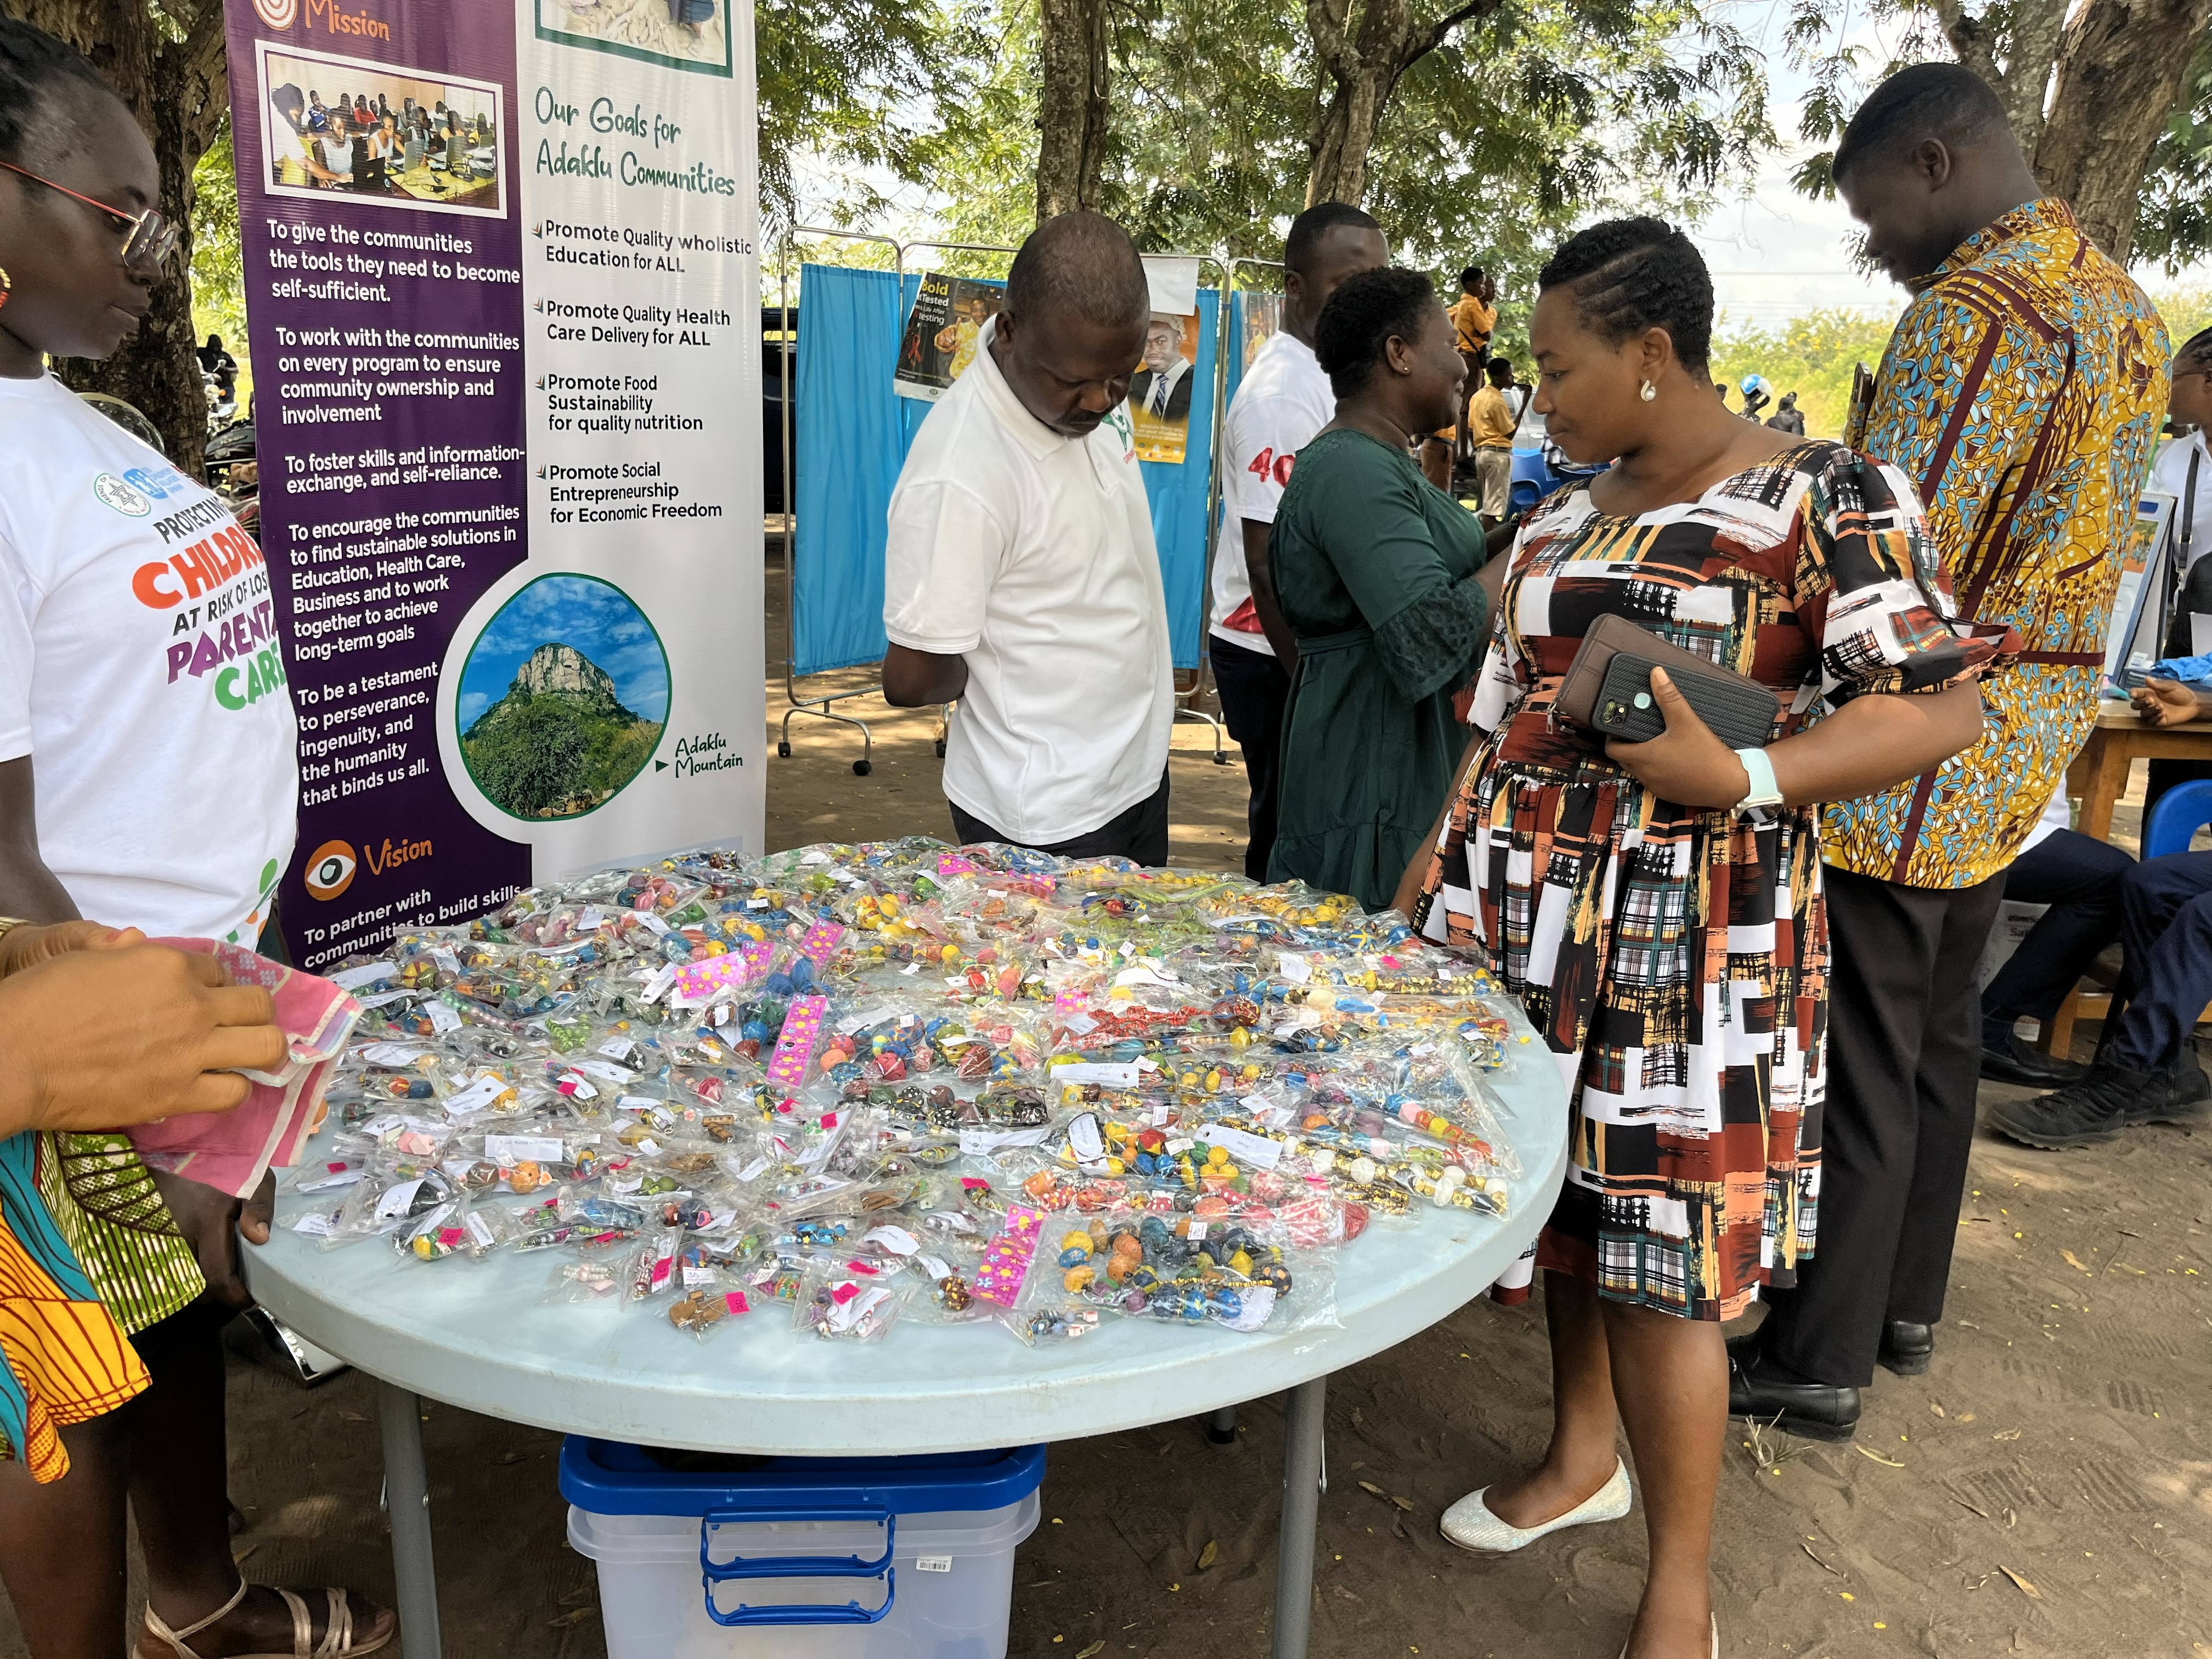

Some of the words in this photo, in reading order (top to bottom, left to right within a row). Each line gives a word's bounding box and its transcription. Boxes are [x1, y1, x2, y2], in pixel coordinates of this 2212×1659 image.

[305, 0, 390, 42] Mission
[535, 86, 579, 126] Our
[590, 97, 647, 139] Goals
[654, 114, 681, 149] for
[536, 138, 612, 179] Adaklu
[621, 151, 735, 196] Communities
[267, 219, 287, 239] To
[292, 224, 326, 244] give
[330, 225, 358, 244] the
[364, 229, 473, 254] communities
[546, 219, 619, 242] Promote
[624, 228, 673, 252] Quality
[678, 234, 752, 255] wholistic
[269, 249, 297, 269] the
[301, 251, 342, 272] tools
[347, 254, 384, 278] they
[388, 259, 427, 278] need
[432, 262, 452, 279] to
[456, 264, 520, 284] become
[546, 245, 629, 268] Education
[634, 253, 652, 269] for
[656, 257, 685, 273] ALL
[272, 278, 391, 302] self-sufficient.
[922, 279, 949, 296] Bold
[922, 294, 949, 306] Tested
[548, 301, 619, 320] Promote
[623, 305, 670, 326] Quality
[676, 308, 730, 325] Health
[276, 328, 296, 346] To
[300, 328, 341, 347] work
[344, 329, 382, 347] with
[385, 329, 410, 347] the
[414, 331, 520, 351] communities
[548, 324, 586, 341] Care
[592, 327, 648, 347] Delivery
[653, 328, 673, 345] for
[679, 331, 710, 346] ALL
[278, 357, 300, 372] on
[304, 357, 348, 376] every
[352, 356, 419, 376] program
[423, 356, 441, 372] to
[445, 358, 501, 373] ensure
[549, 374, 620, 391] Promote
[625, 375, 657, 391] Food
[280, 379, 372, 401] community
[376, 378, 459, 399] ownership
[464, 379, 494, 396] and
[549, 394, 652, 414] Sustainability
[282, 404, 382, 425] involvement
[549, 415, 572, 431] for
[578, 415, 631, 434] quality
[635, 415, 703, 430] nutrition
[285, 455, 305, 473] To
[309, 453, 355, 472] foster
[358, 449, 396, 467] skills
[399, 447, 425, 466] and
[429, 445, 525, 464] information-
[550, 464, 618, 480] Promote
[622, 462, 660, 478] Social
[1248, 447, 1295, 488] 40
[286, 473, 367, 494] exchange,
[370, 467, 399, 486] and
[403, 464, 503, 483] self-reliance.
[550, 482, 679, 504] Entrepreneurship
[289, 524, 309, 542] To
[312, 517, 392, 539] encourage
[395, 512, 419, 529] the
[422, 505, 520, 526] communities
[550, 507, 573, 523] for
[579, 504, 647, 522] Economic
[652, 502, 722, 518] Freedom
[290, 550, 308, 567] to
[312, 543, 342, 563] find
[346, 533, 427, 559] sustainable
[431, 528, 501, 548] solutions
[504, 526, 516, 542] in
[291, 565, 374, 591] Education,
[376, 557, 423, 579] Health
[426, 552, 466, 571] Care,
[173, 606, 201, 636] AT
[207, 590, 234, 622] RISK
[236, 580, 248, 605] OF
[249, 569, 269, 597] LOS
[293, 590, 361, 614] Business
[363, 584, 392, 602] and
[394, 581, 410, 597] to
[413, 574, 450, 594] work
[294, 612, 363, 639] together
[365, 608, 381, 624] to
[384, 600, 438, 621] achieve
[295, 633, 374, 662] long-term
[376, 624, 415, 649] goals
[297, 689, 319, 706] To
[323, 683, 345, 701] be
[348, 682, 358, 696] a
[360, 661, 438, 692] testament
[298, 715, 318, 731] to
[323, 690, 430, 731] perseverance,
[301, 724, 381, 757] ingenuity,
[385, 714, 414, 737] and
[675, 732, 727, 758] Adaklu
[302, 764, 330, 783] the
[335, 741, 408, 774] humanity
[675, 752, 743, 778] Mountain
[303, 785, 338, 807] that
[342, 770, 384, 796] binds
[387, 765, 405, 781] us
[409, 758, 430, 776] all.
[364, 838, 433, 876] Vision
[304, 929, 325, 945] To
[330, 904, 392, 939] partner
[396, 889, 431, 912] with
[419, 913, 435, 927] to
[439, 895, 477, 920] build
[483, 885, 521, 906] skills
